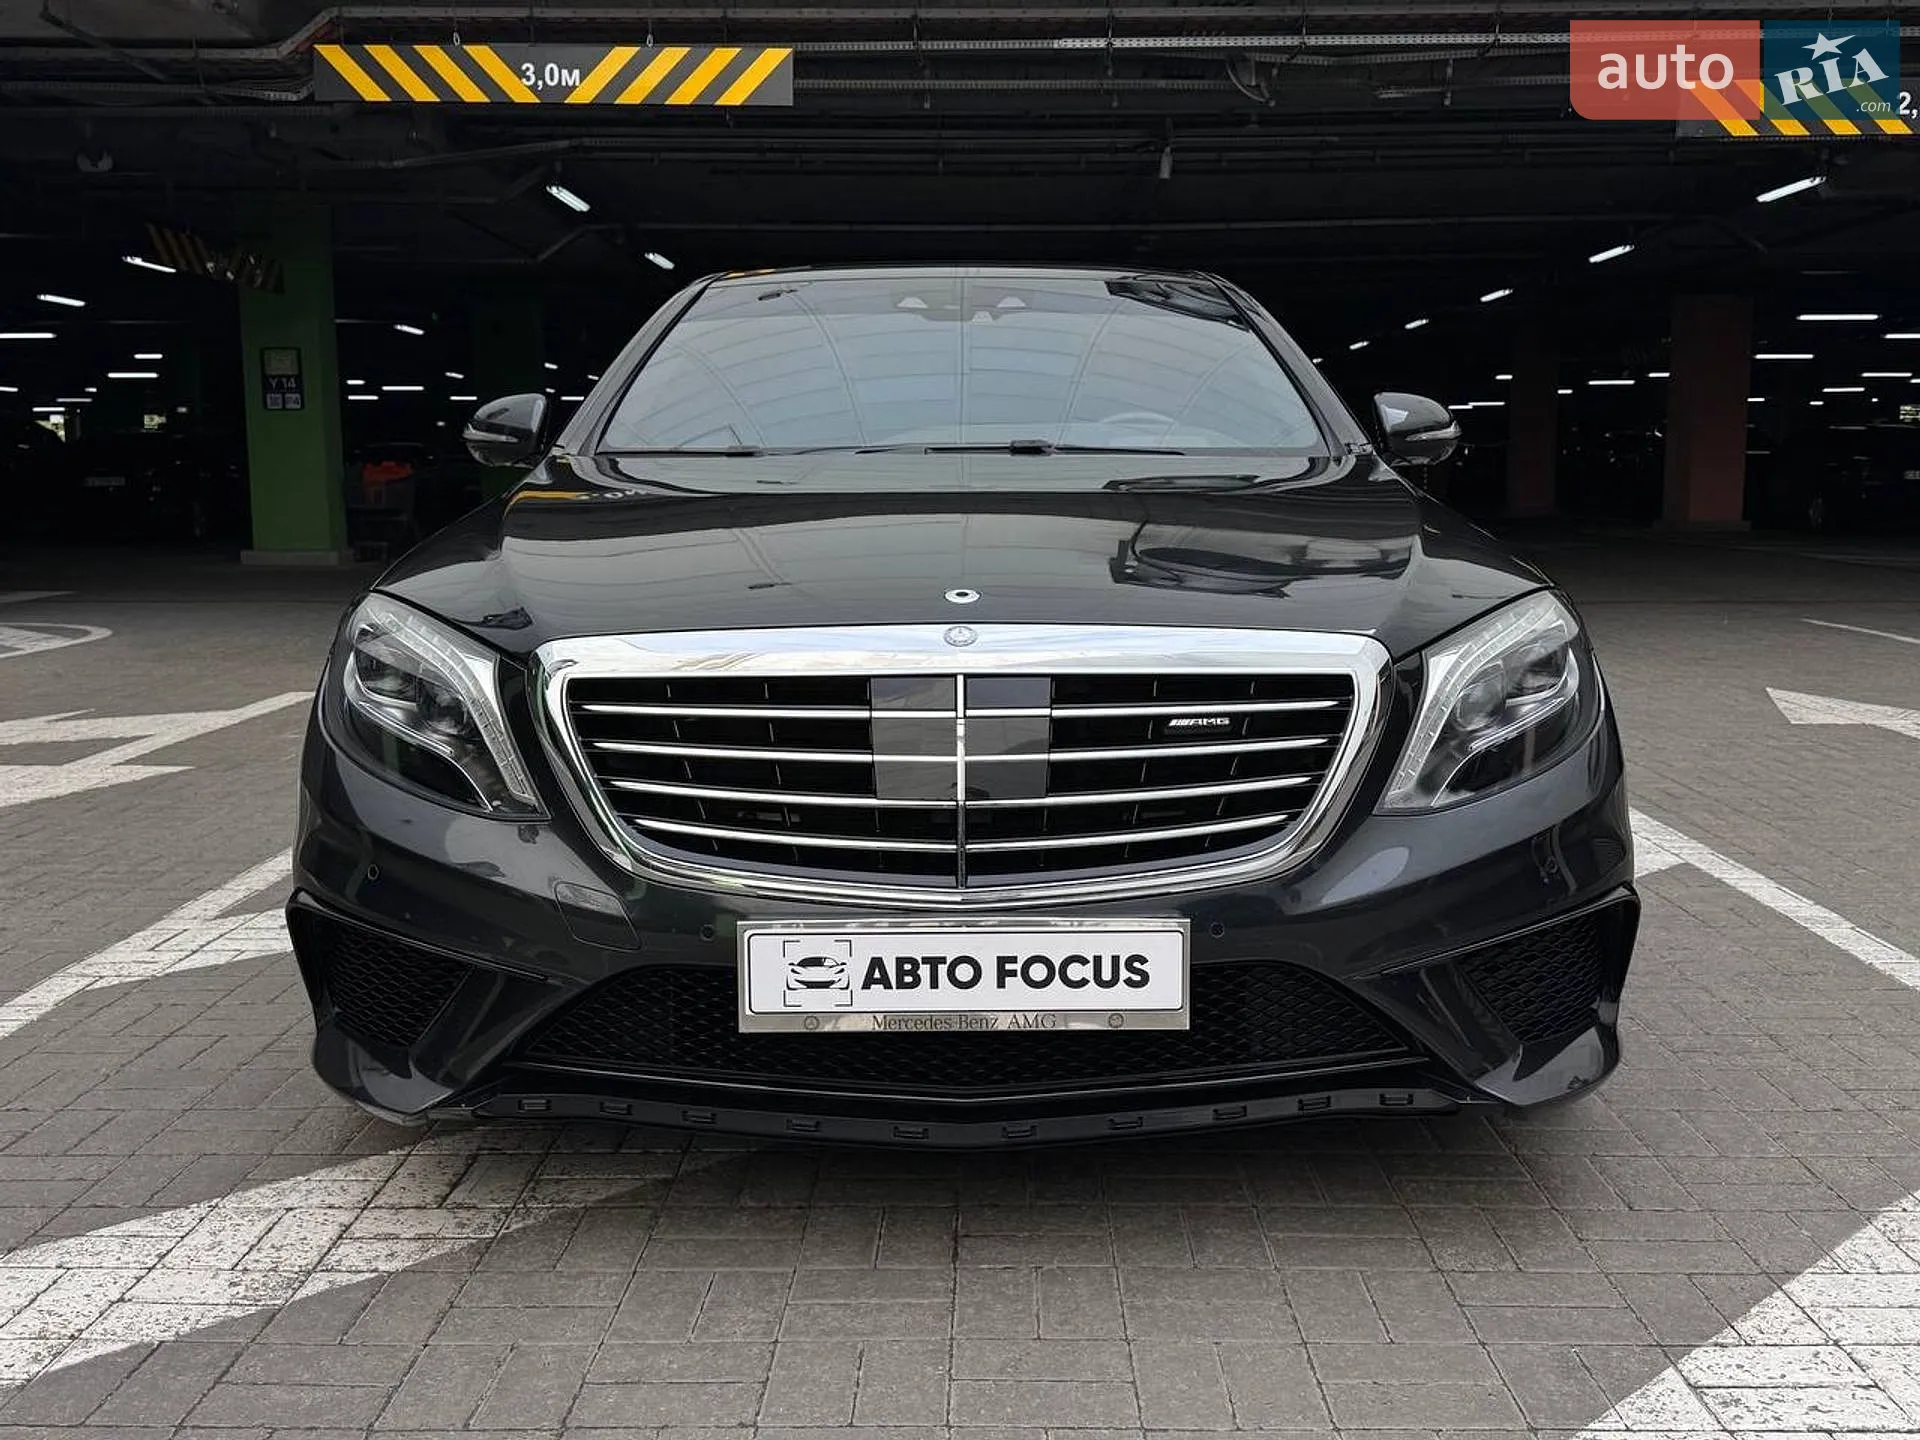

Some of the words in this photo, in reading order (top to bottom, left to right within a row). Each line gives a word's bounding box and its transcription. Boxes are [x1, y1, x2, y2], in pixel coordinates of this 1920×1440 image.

[521, 62, 581, 91] 3,0м
[861, 955, 983, 990] АВТО
[995, 954, 1150, 990] FOCUS
[1007, 1014, 1057, 1030] AMG
